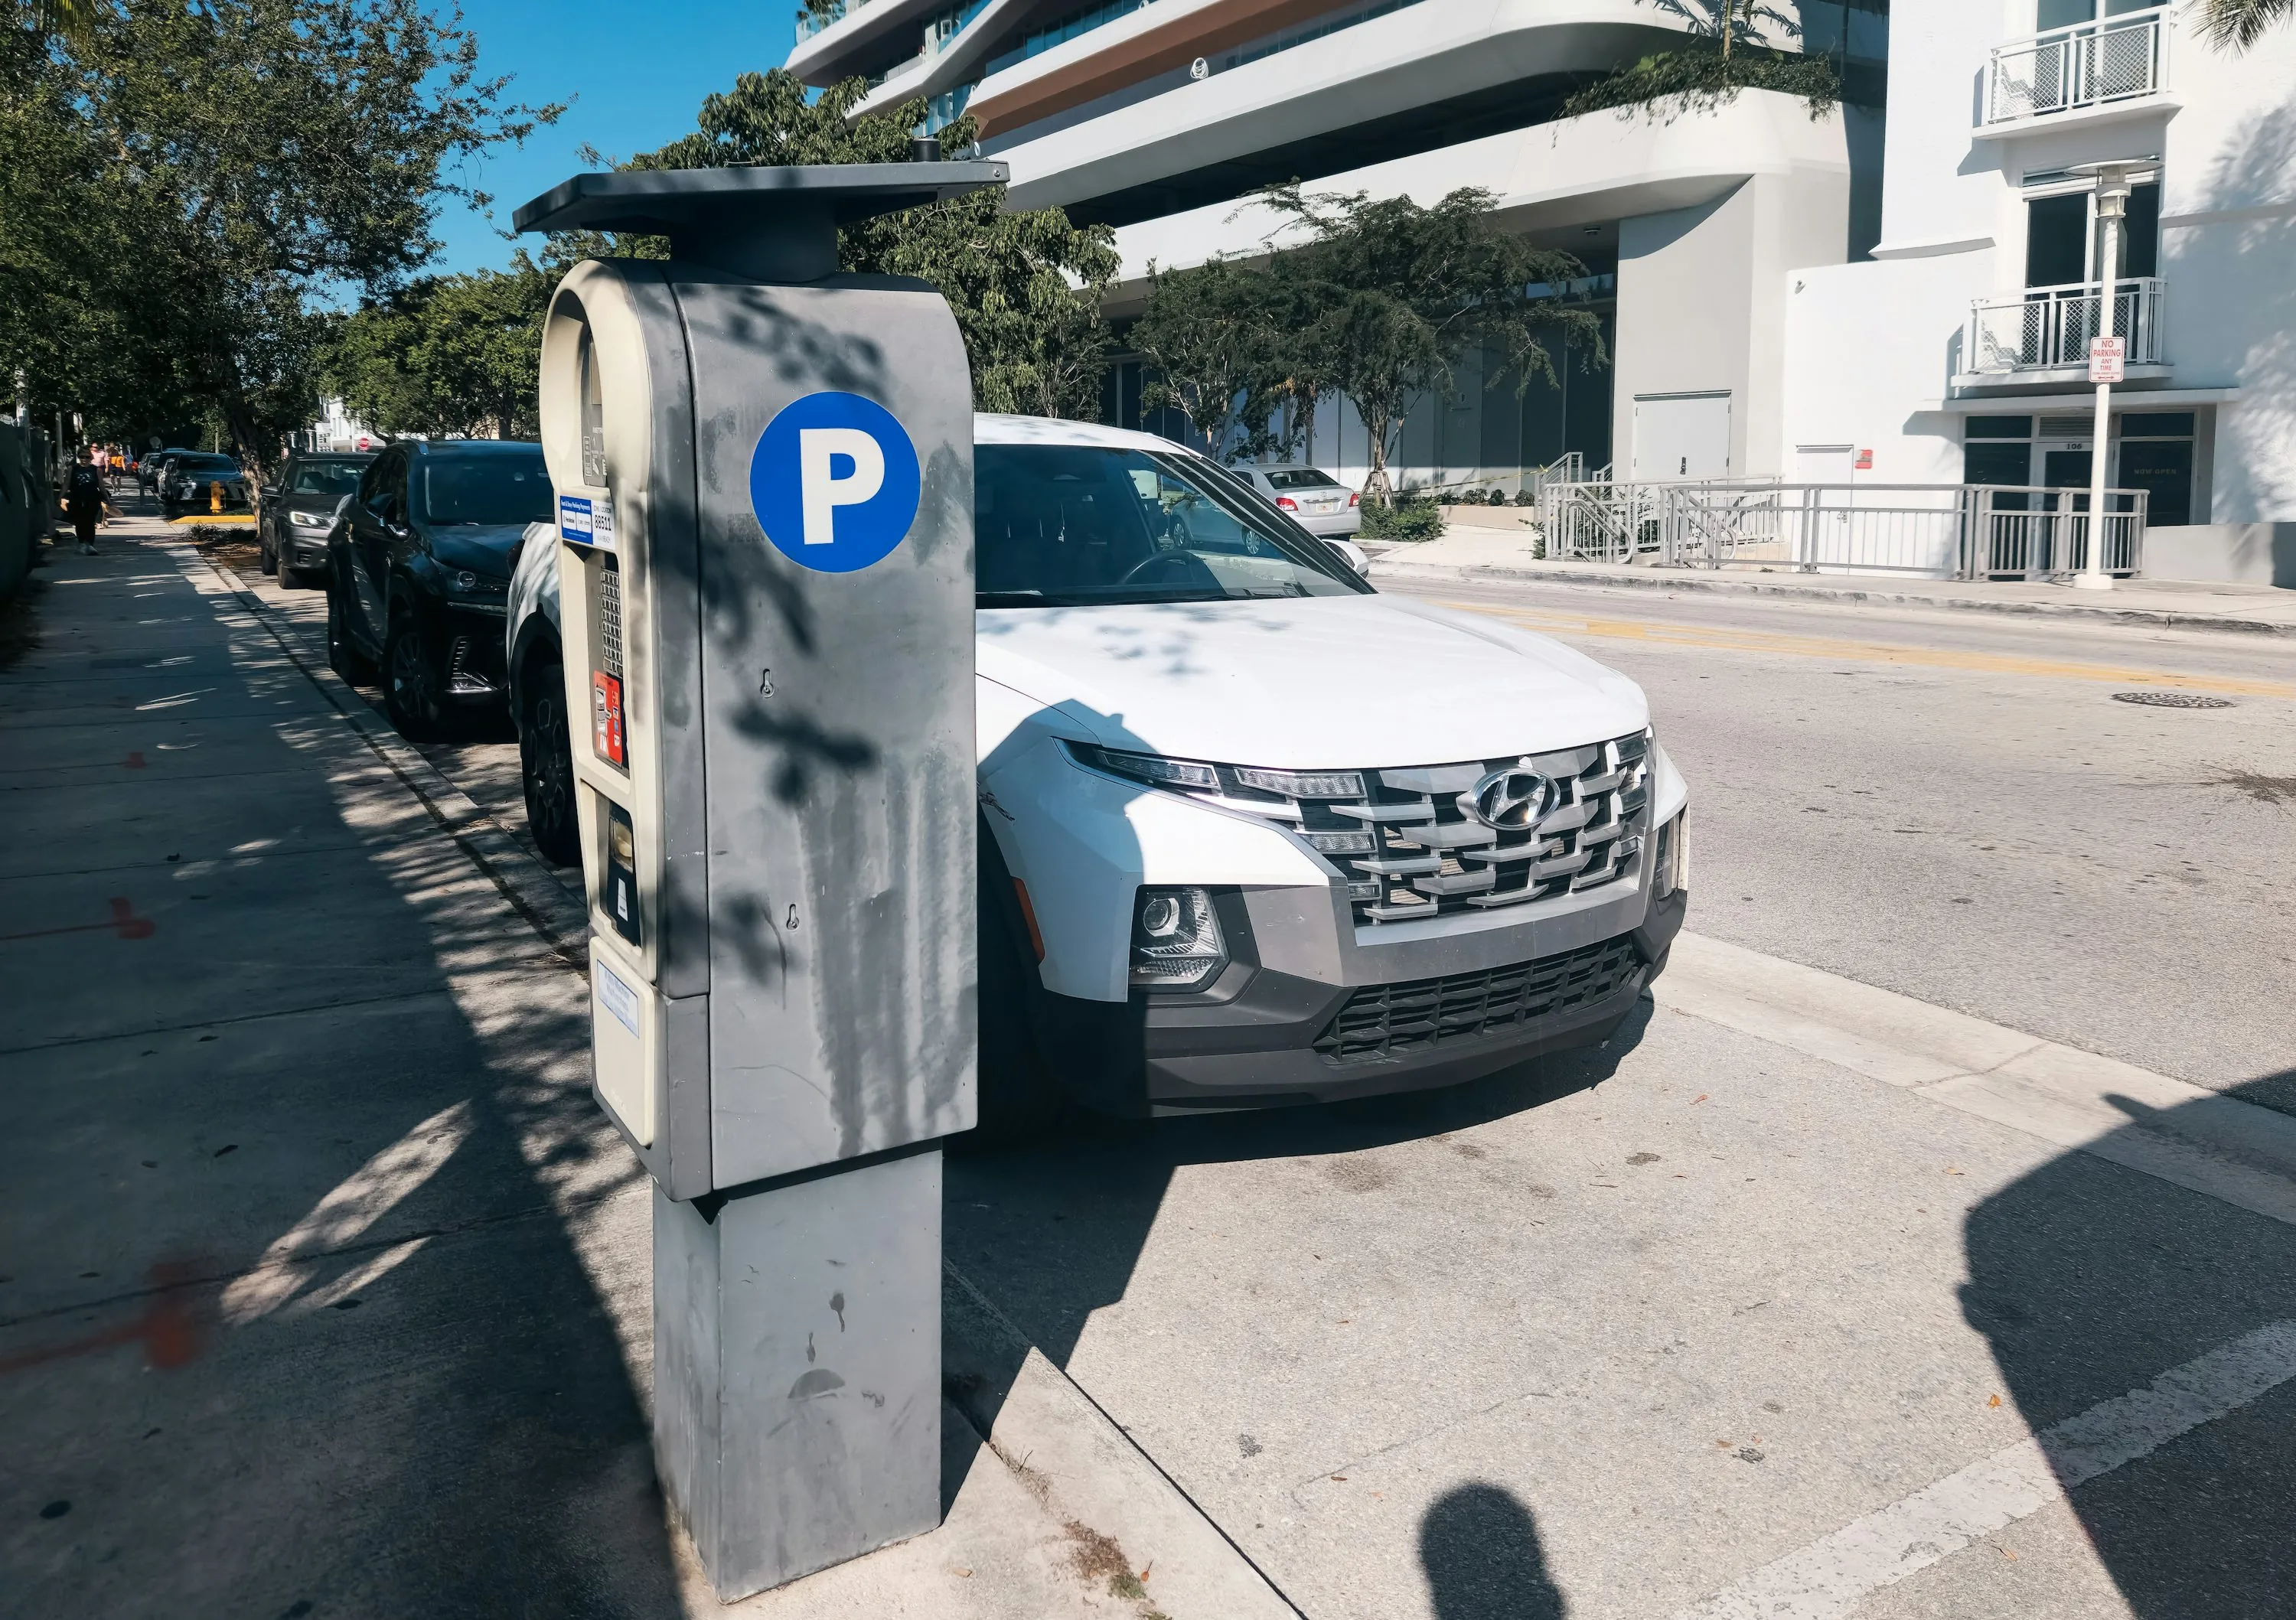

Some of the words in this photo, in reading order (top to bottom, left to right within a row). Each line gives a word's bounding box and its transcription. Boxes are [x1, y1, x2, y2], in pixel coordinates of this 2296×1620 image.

[2101, 340, 2114, 348] NO
[2093, 349, 2121, 357] PARKING
[800, 428, 885, 545] P
[595, 514, 612, 531] 88511
